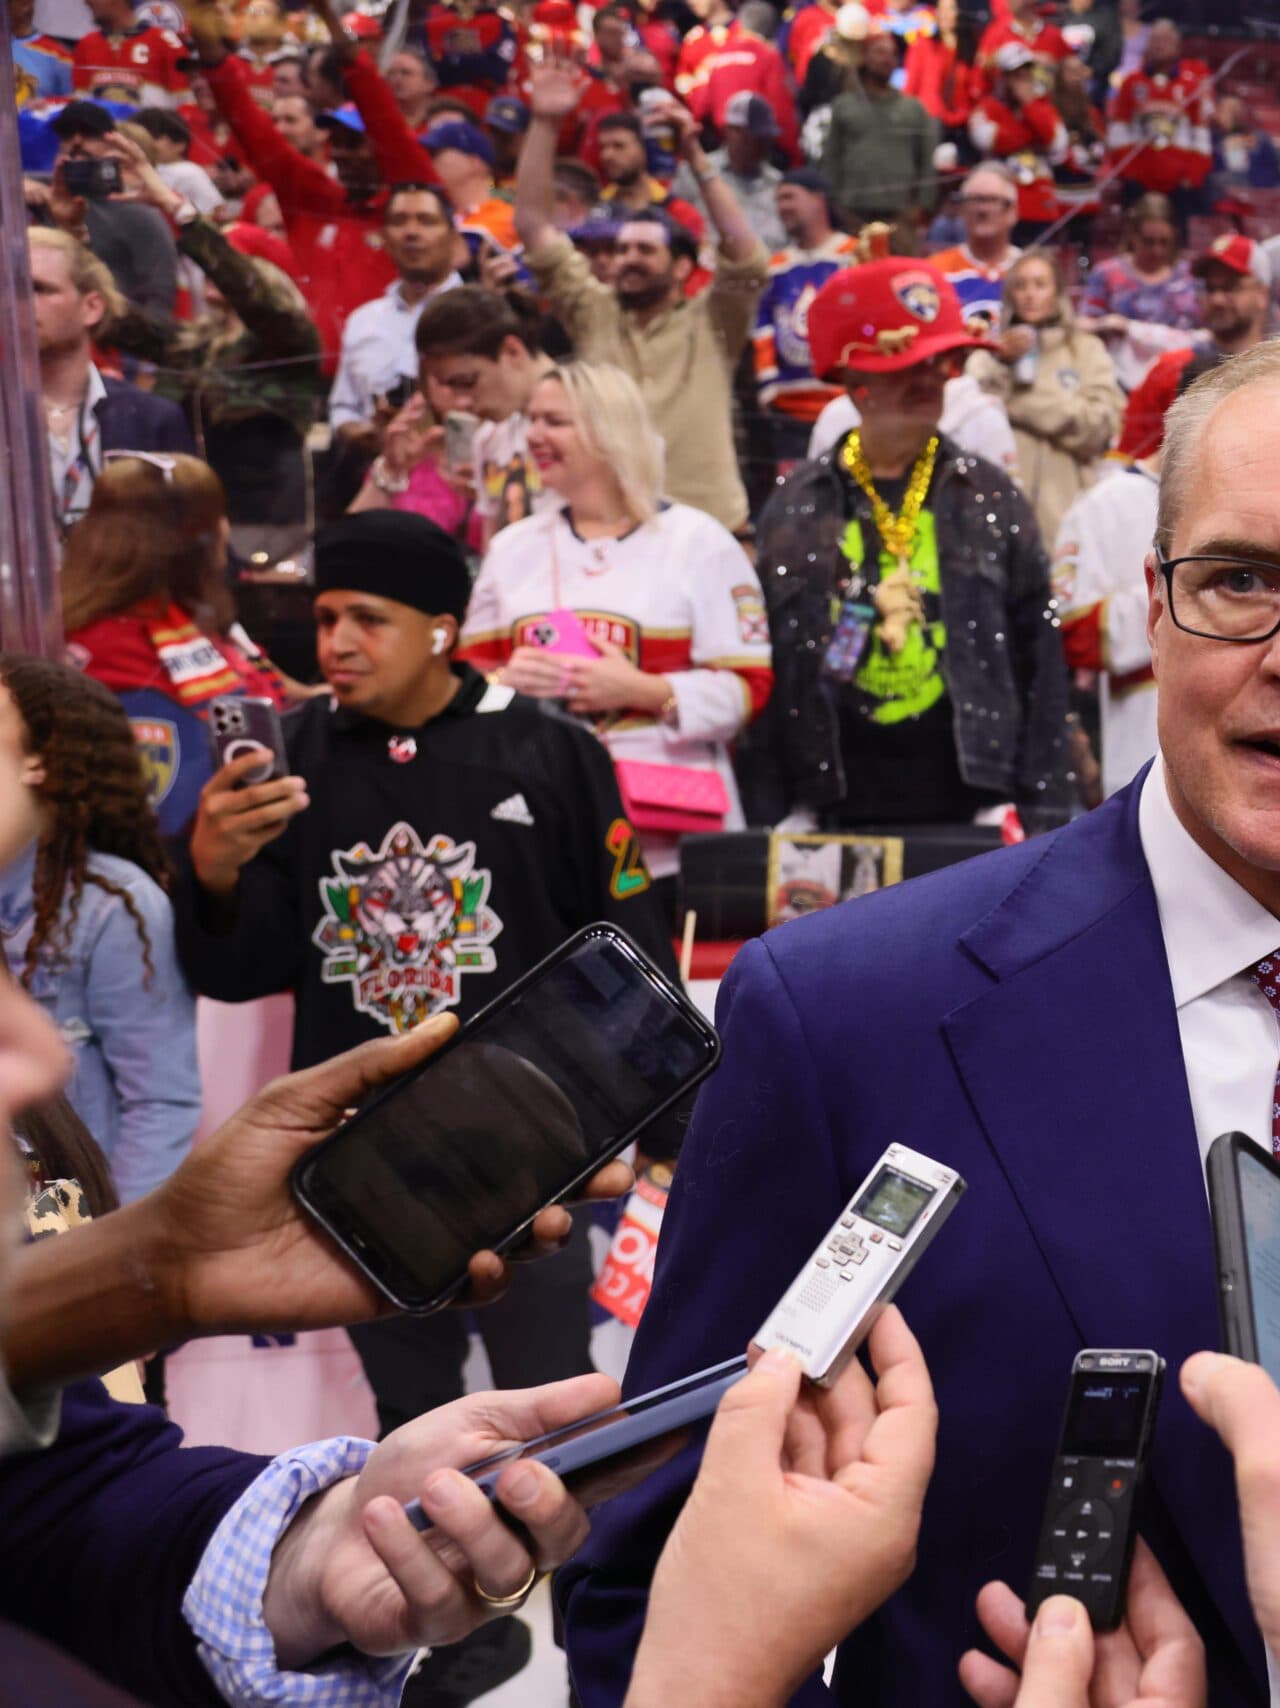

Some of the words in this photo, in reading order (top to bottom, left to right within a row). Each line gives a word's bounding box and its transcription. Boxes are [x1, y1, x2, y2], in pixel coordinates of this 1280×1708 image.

[605, 818, 650, 900] 2
[358, 966, 455, 1005] FLORIDA
[1099, 1357, 1131, 1367] SONY
